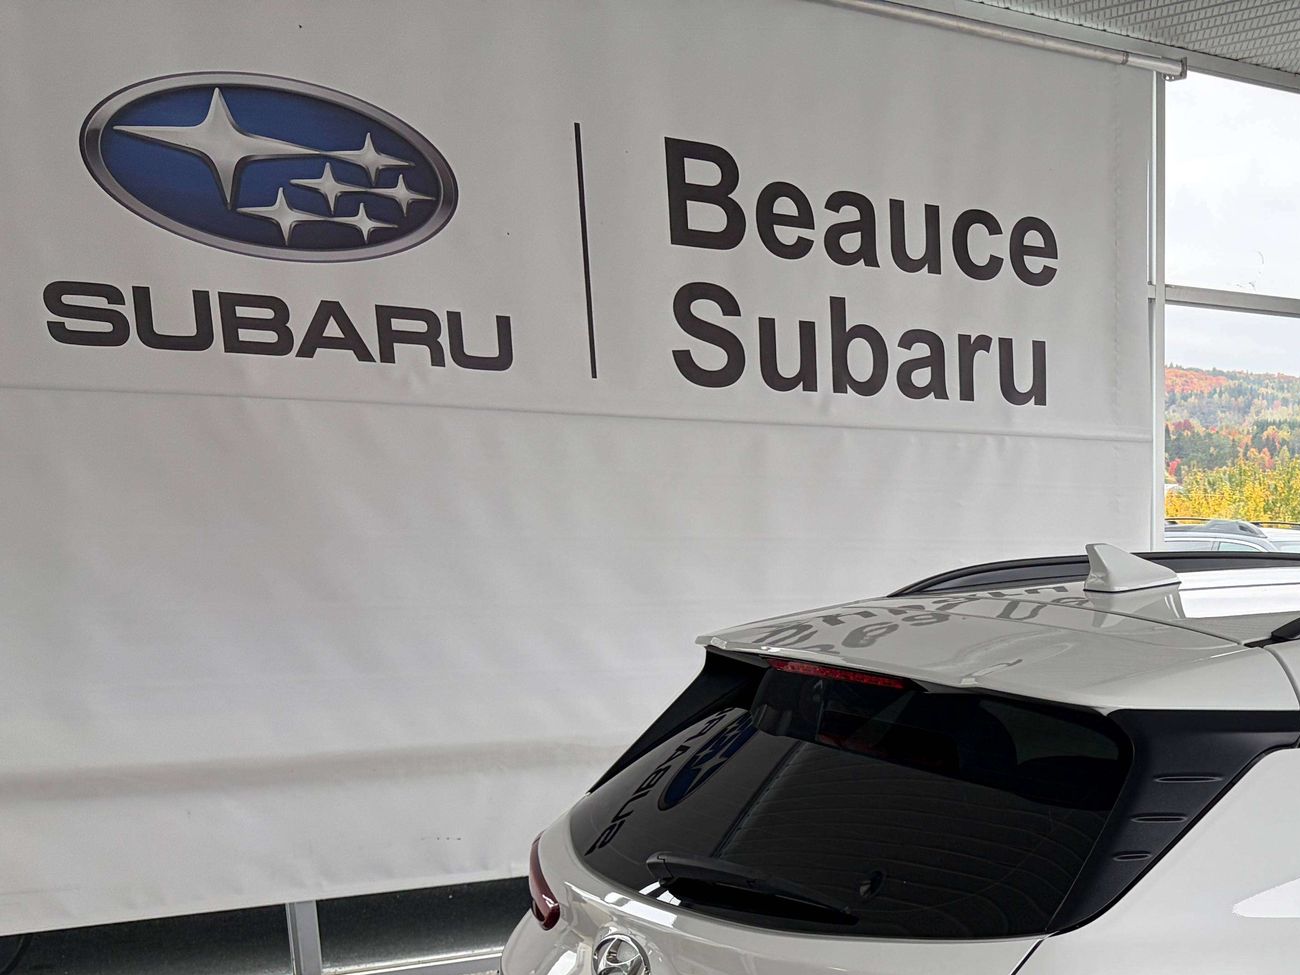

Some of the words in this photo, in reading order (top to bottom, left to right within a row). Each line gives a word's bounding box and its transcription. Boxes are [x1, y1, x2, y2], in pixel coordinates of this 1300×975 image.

[663, 136, 1059, 288] Beauce
[42, 280, 513, 372] SUBARU
[670, 281, 1050, 407] Subaru
